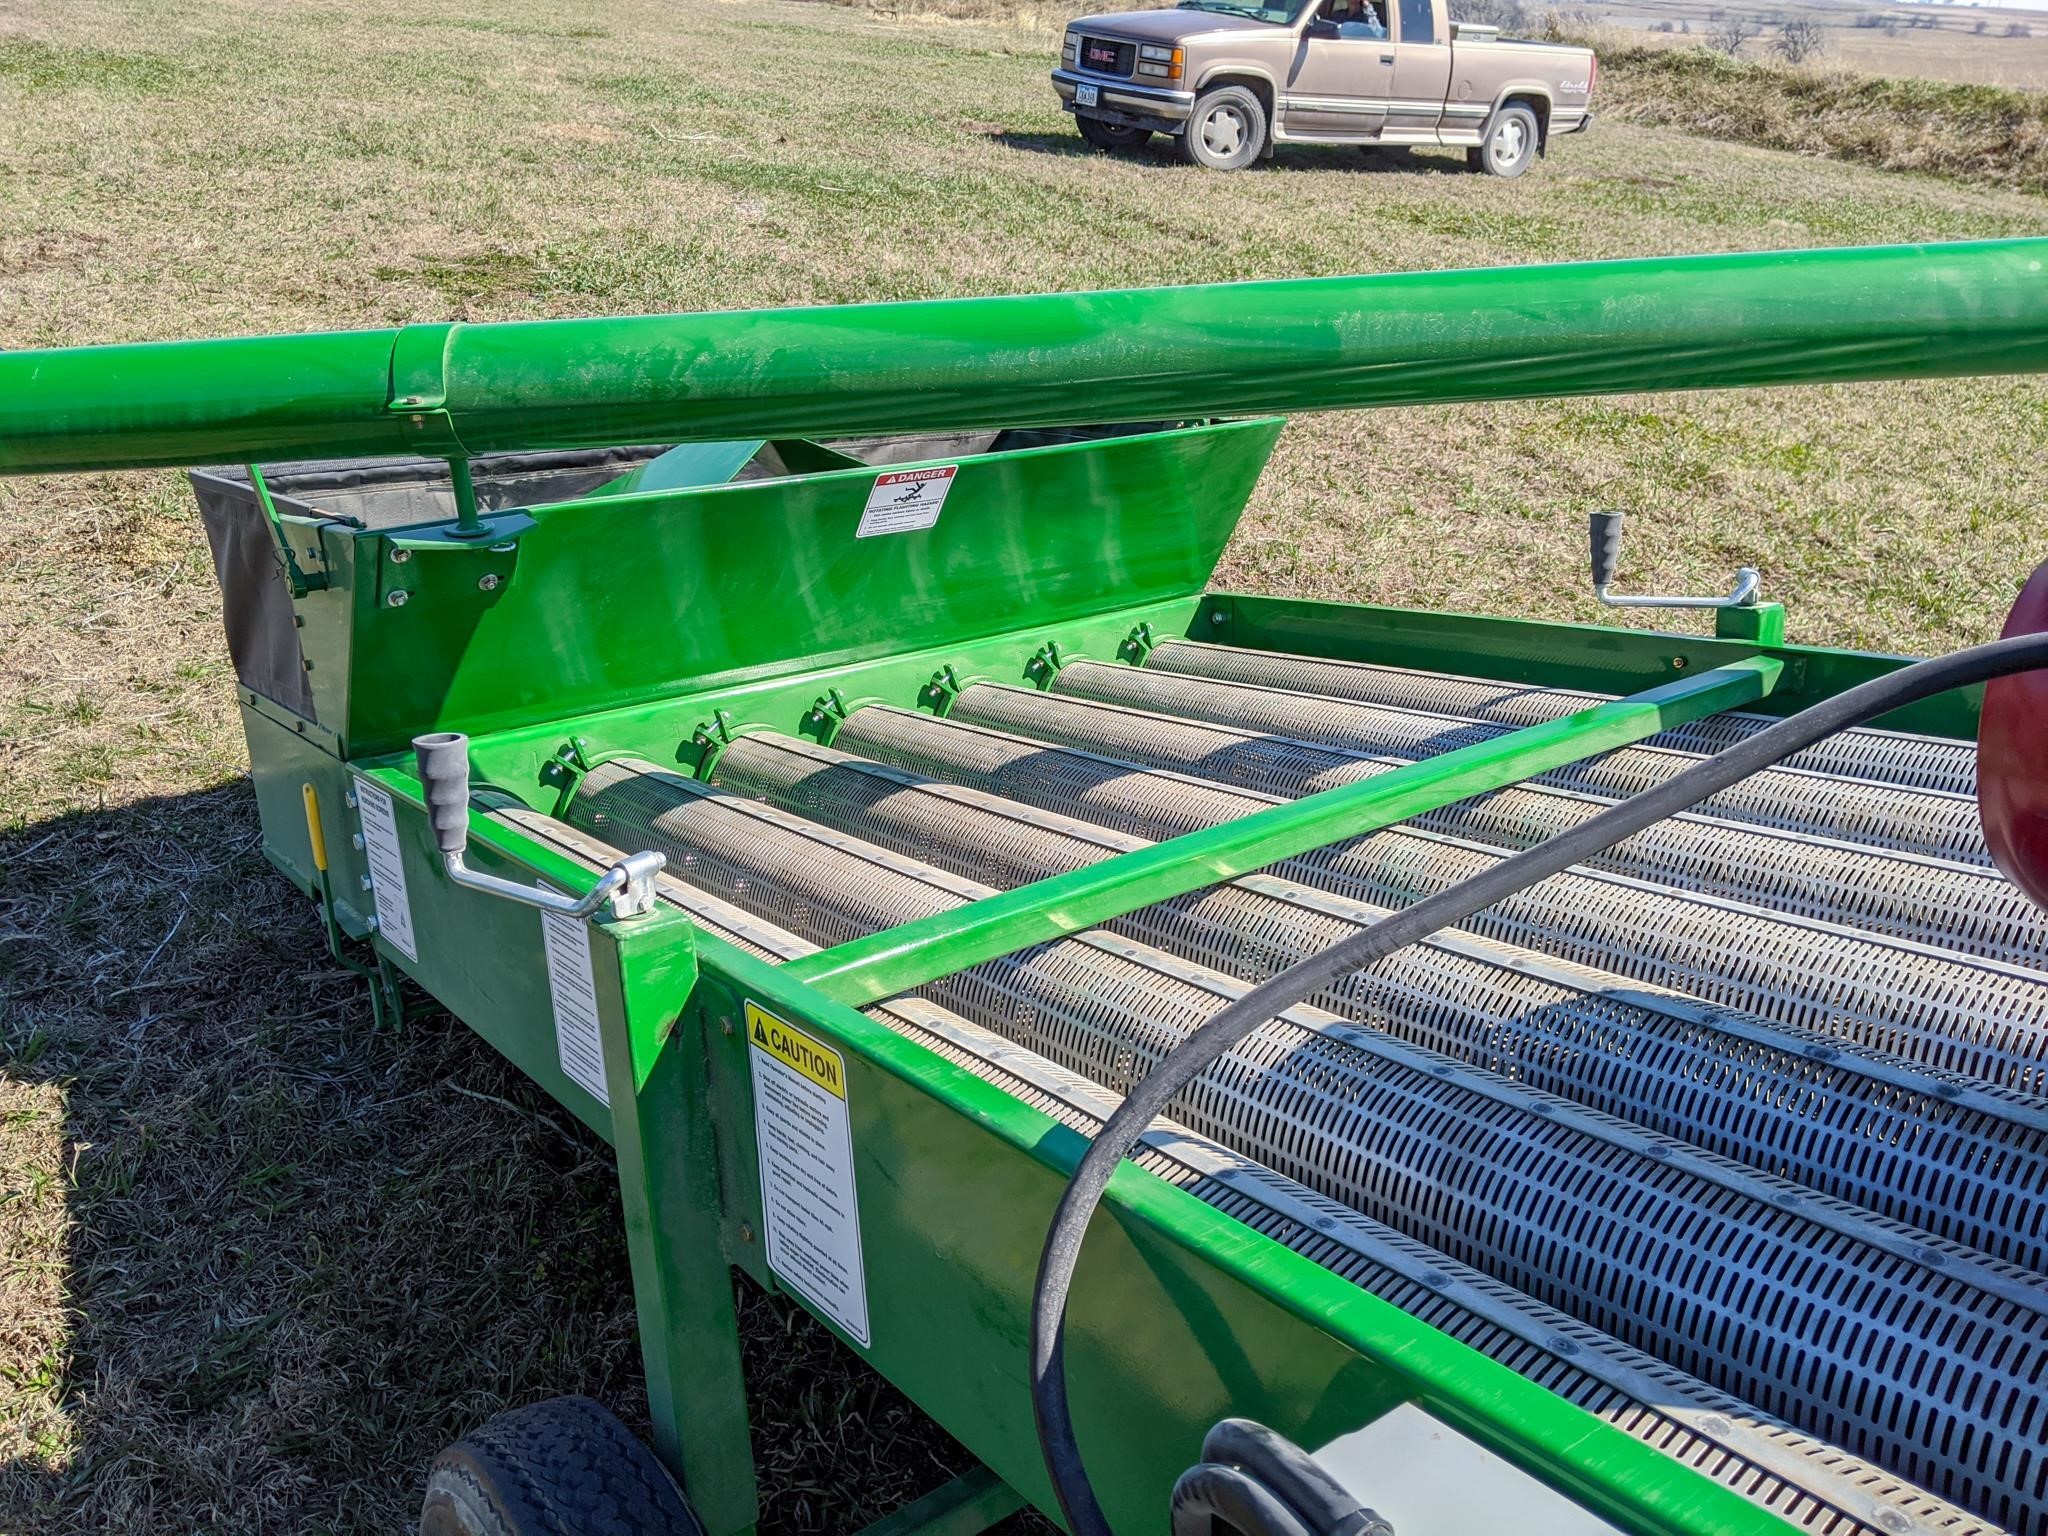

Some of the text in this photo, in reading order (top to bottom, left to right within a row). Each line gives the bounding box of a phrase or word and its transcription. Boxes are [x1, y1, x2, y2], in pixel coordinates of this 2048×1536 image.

[1090, 48, 1115, 63] GMC
[898, 469, 947, 482] DANGER
[771, 1029, 837, 1086] CAUTION
